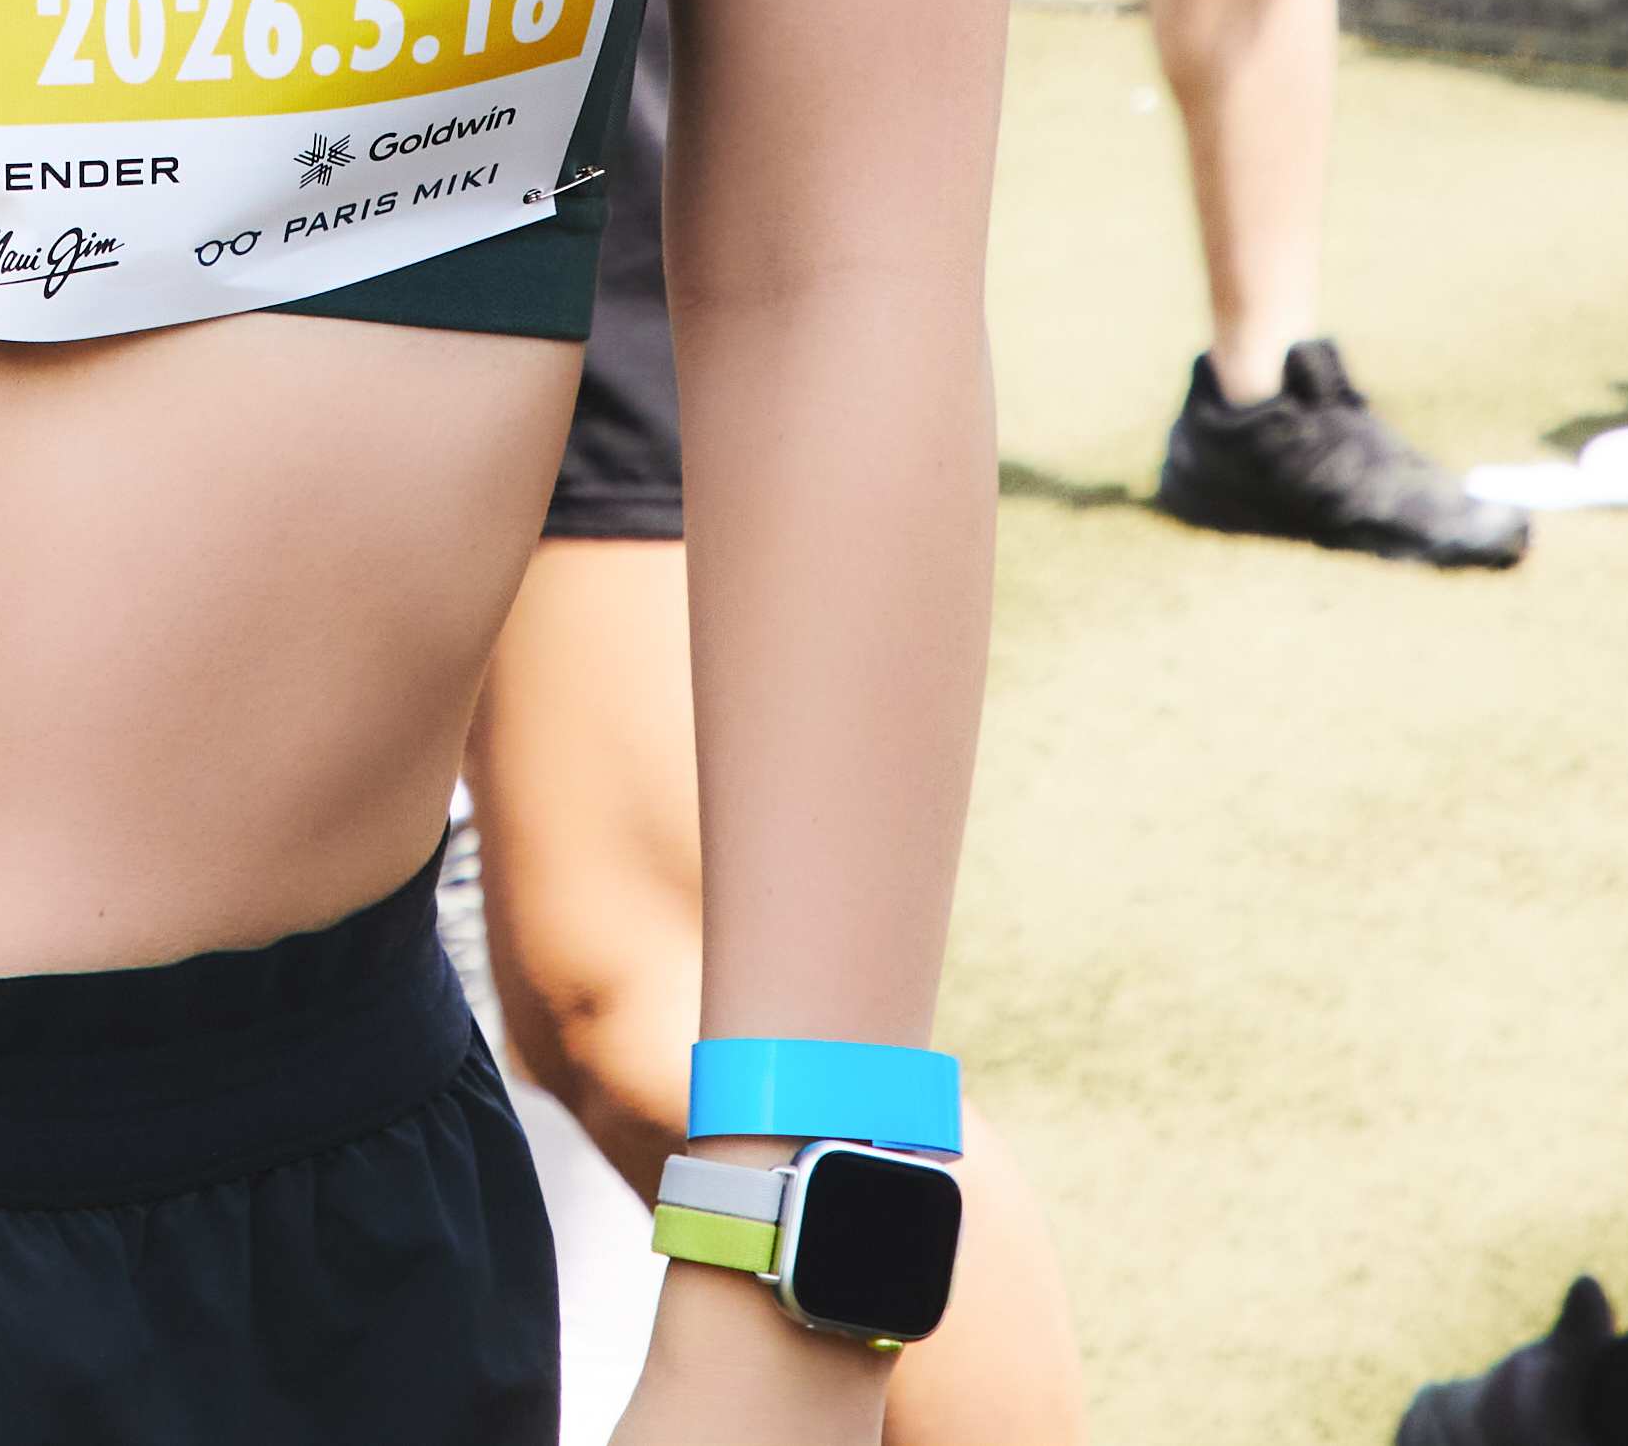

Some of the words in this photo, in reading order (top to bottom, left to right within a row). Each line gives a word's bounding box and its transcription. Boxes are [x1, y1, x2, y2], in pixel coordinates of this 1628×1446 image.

[368, 106, 517, 161] Goldwin
[283, 192, 399, 243] PARIS
[412, 163, 500, 206] MIKI
[43, 227, 126, 300] Jim
